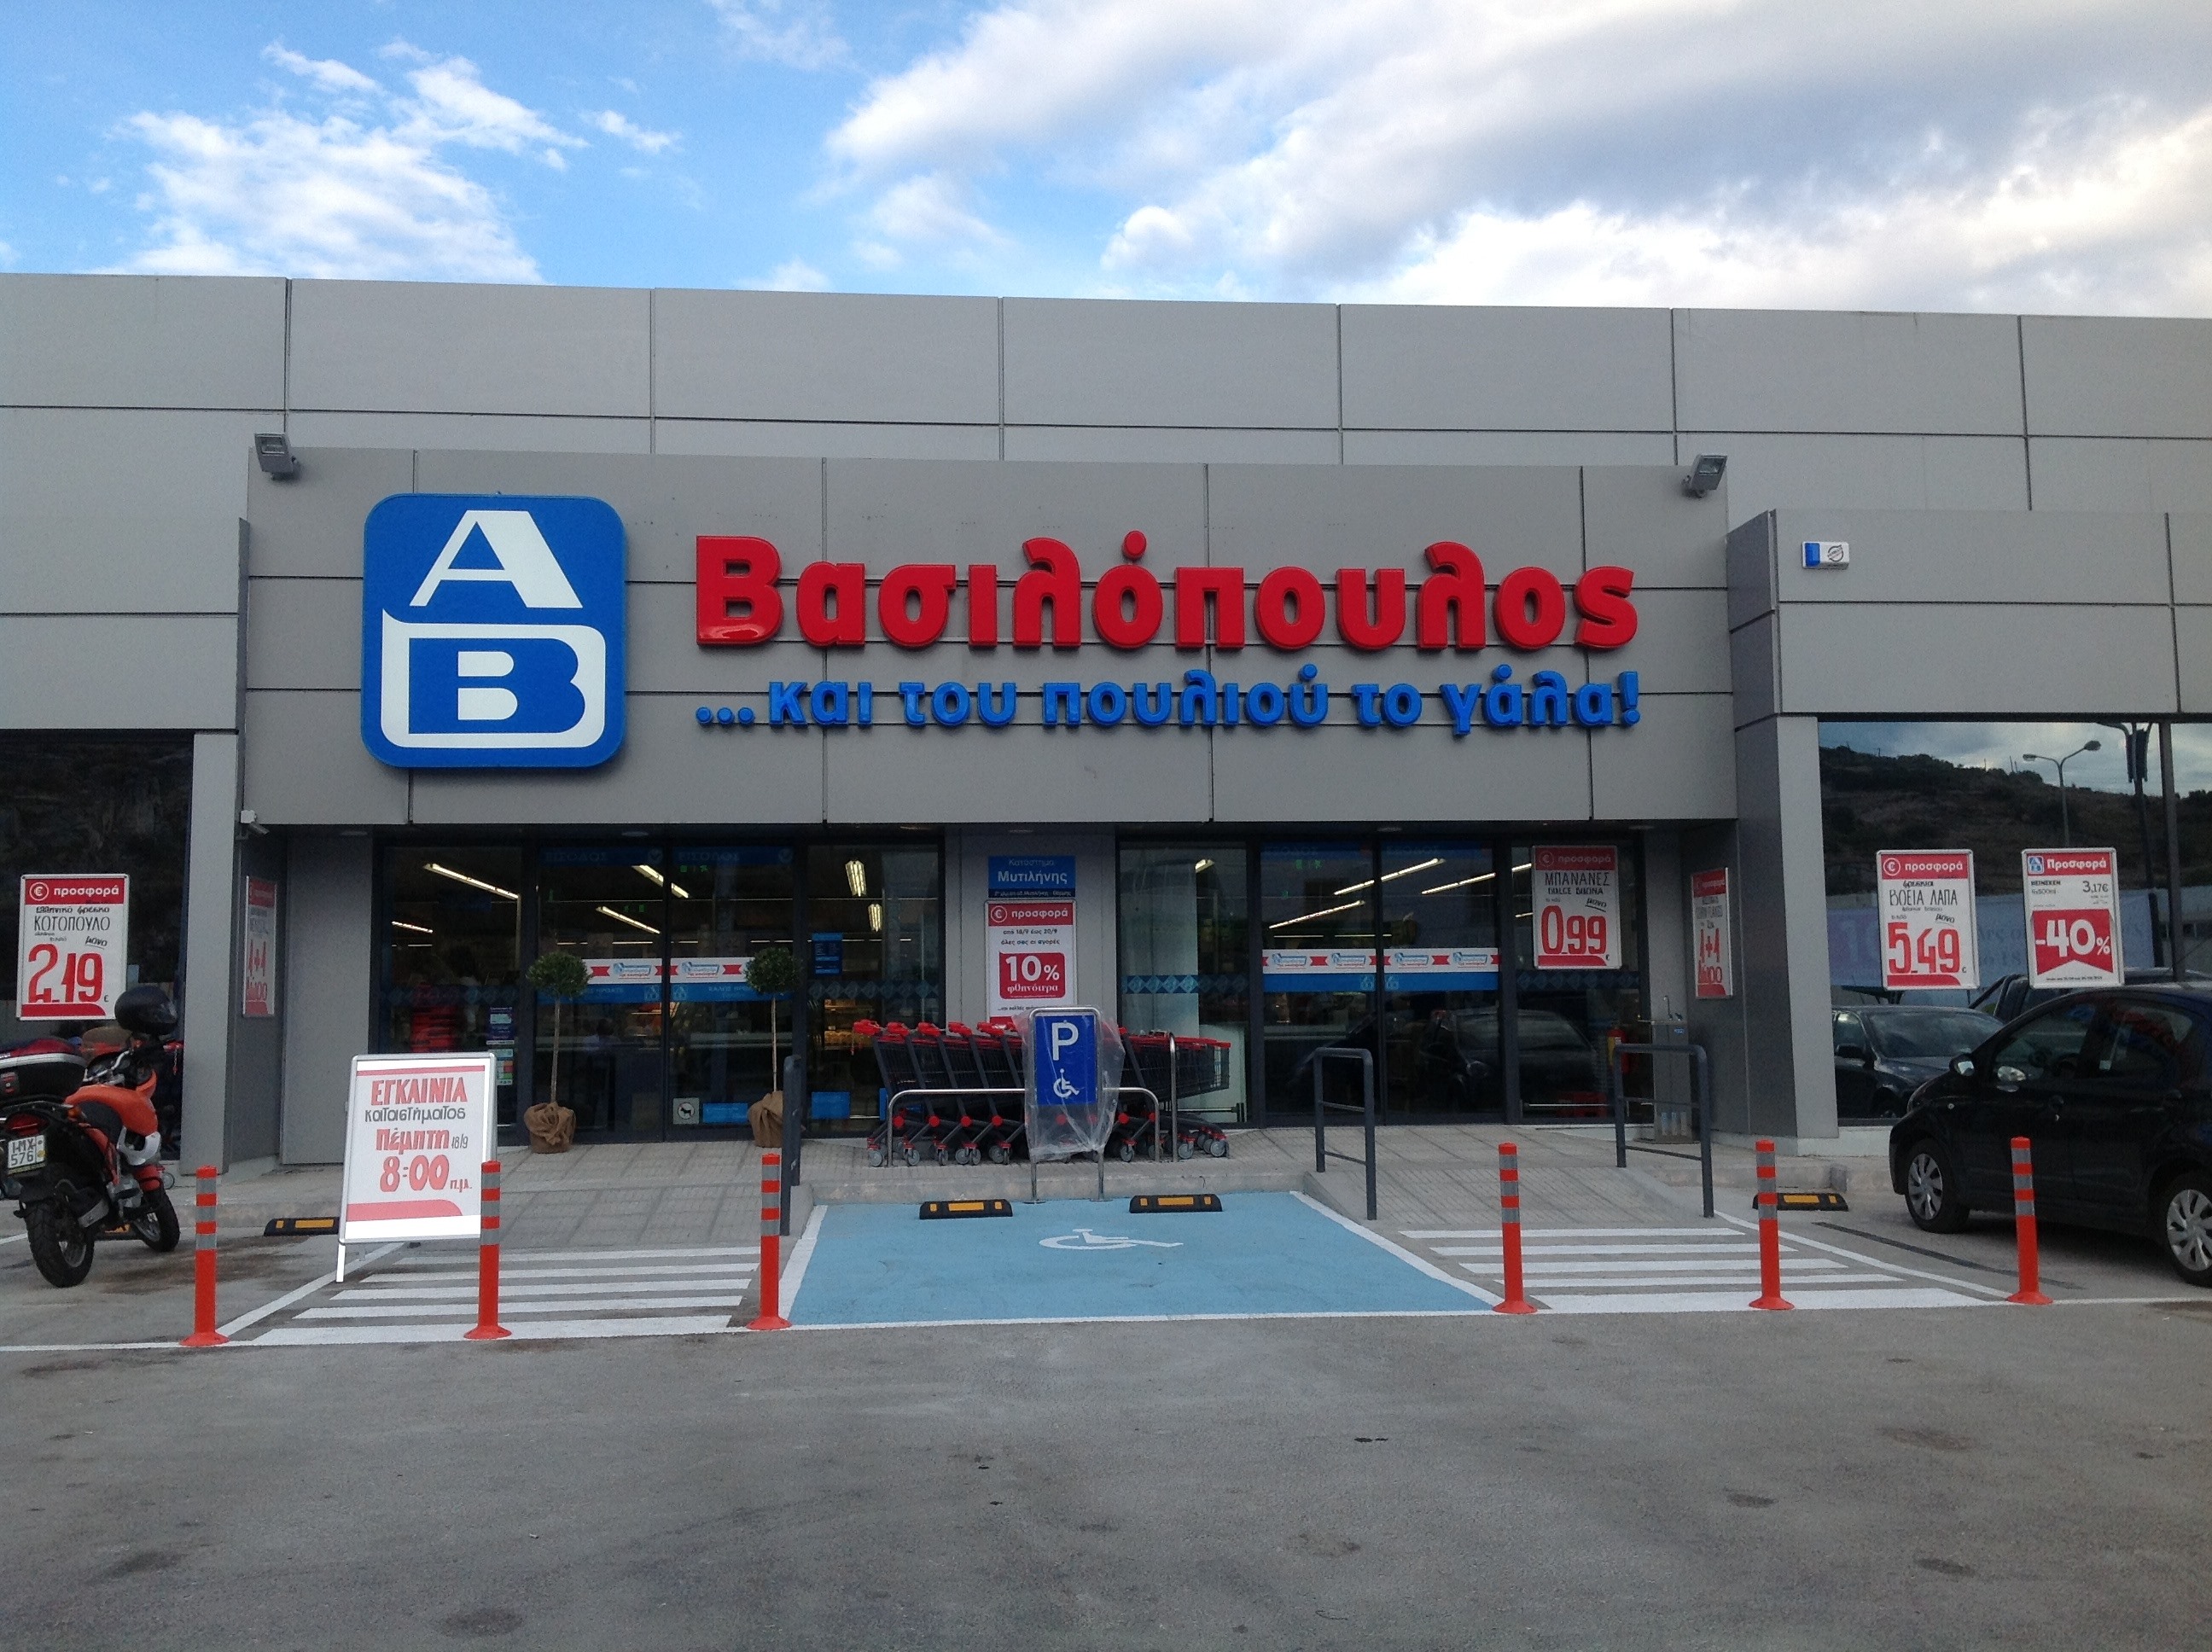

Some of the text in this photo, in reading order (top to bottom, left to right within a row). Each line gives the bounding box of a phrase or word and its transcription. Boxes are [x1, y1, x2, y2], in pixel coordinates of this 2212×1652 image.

[696, 530, 1639, 651] Βασιλόπουλος
[899, 681, 1016, 728] του
[1042, 664, 1329, 728] πουλιού
[1352, 682, 1423, 728] το
[1440, 664, 1641, 736] γάλα!
[1557, 854, 1611, 864] προσφορά
[1904, 861, 1963, 871] προσφορά
[2046, 853, 2107, 870] Προσφορά
[998, 870, 1068, 885] Μυτιλήνης
[1545, 872, 1610, 887] ΜΠΑΝΑΝΕΣ
[54, 885, 119, 898] προσφορά
[1889, 889, 1958, 906] ΒΟΕΙΑ ΛΑΠΑ
[1011, 907, 1068, 919] προσφορά
[34, 916, 111, 932] ΚΟΤΟΠΟΥΛΟ
[2035, 918, 2110, 958] -40%
[1005, 955, 1060, 981] 10%
[1051, 1022, 1079, 1061] P
[370, 1076, 468, 1106] ΕΓΚΑΙΝΙΑ
[364, 1105, 466, 1124] καταστήματος
[375, 1127, 469, 1155] Πέμπτη 18/9
[10, 1150, 34, 1166] 576
[380, 1154, 450, 1193] 8:00
